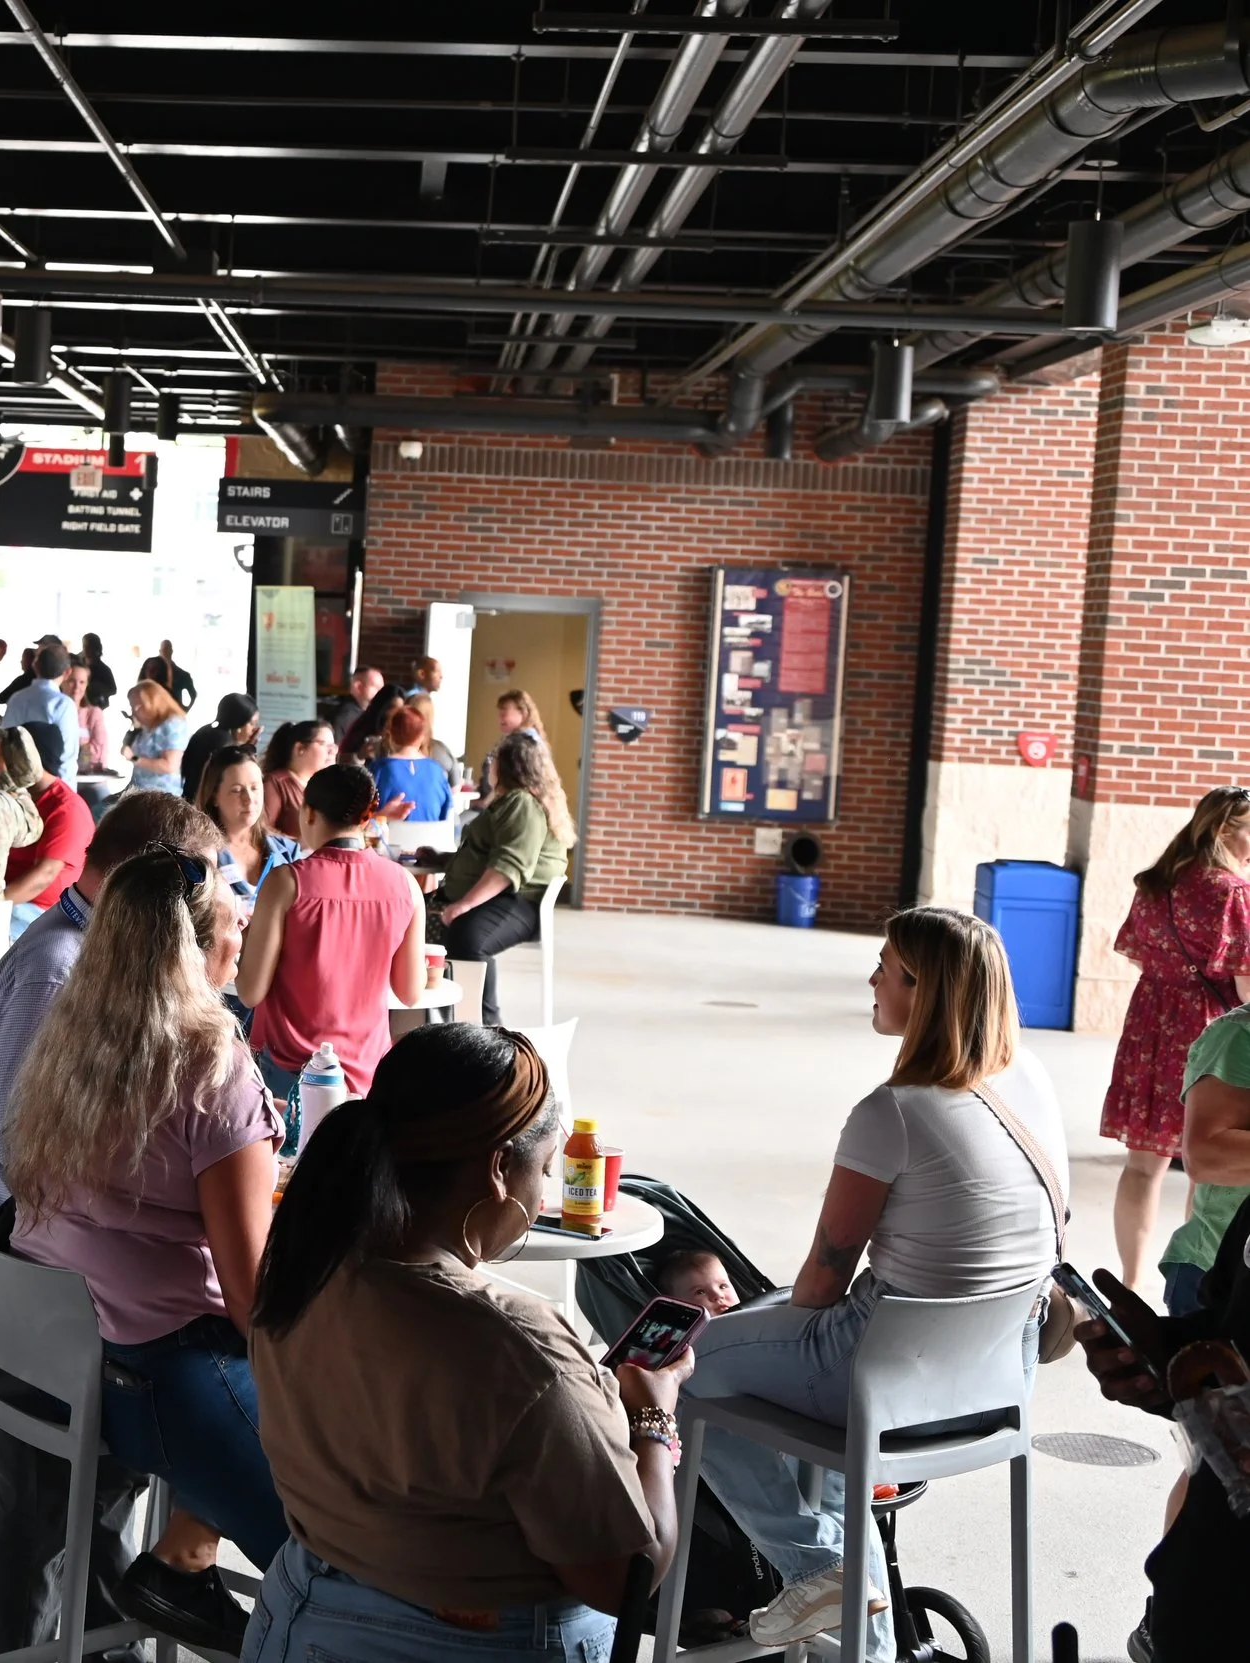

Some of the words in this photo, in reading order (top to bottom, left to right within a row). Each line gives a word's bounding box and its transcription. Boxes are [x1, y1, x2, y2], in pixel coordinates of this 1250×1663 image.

[32, 453, 105, 466] STADIUM
[227, 486, 271, 498] STAIRS
[225, 515, 290, 528] ELEVATOR
[568, 1187, 584, 1197] ICED
[585, 1188, 597, 1197] TEA
